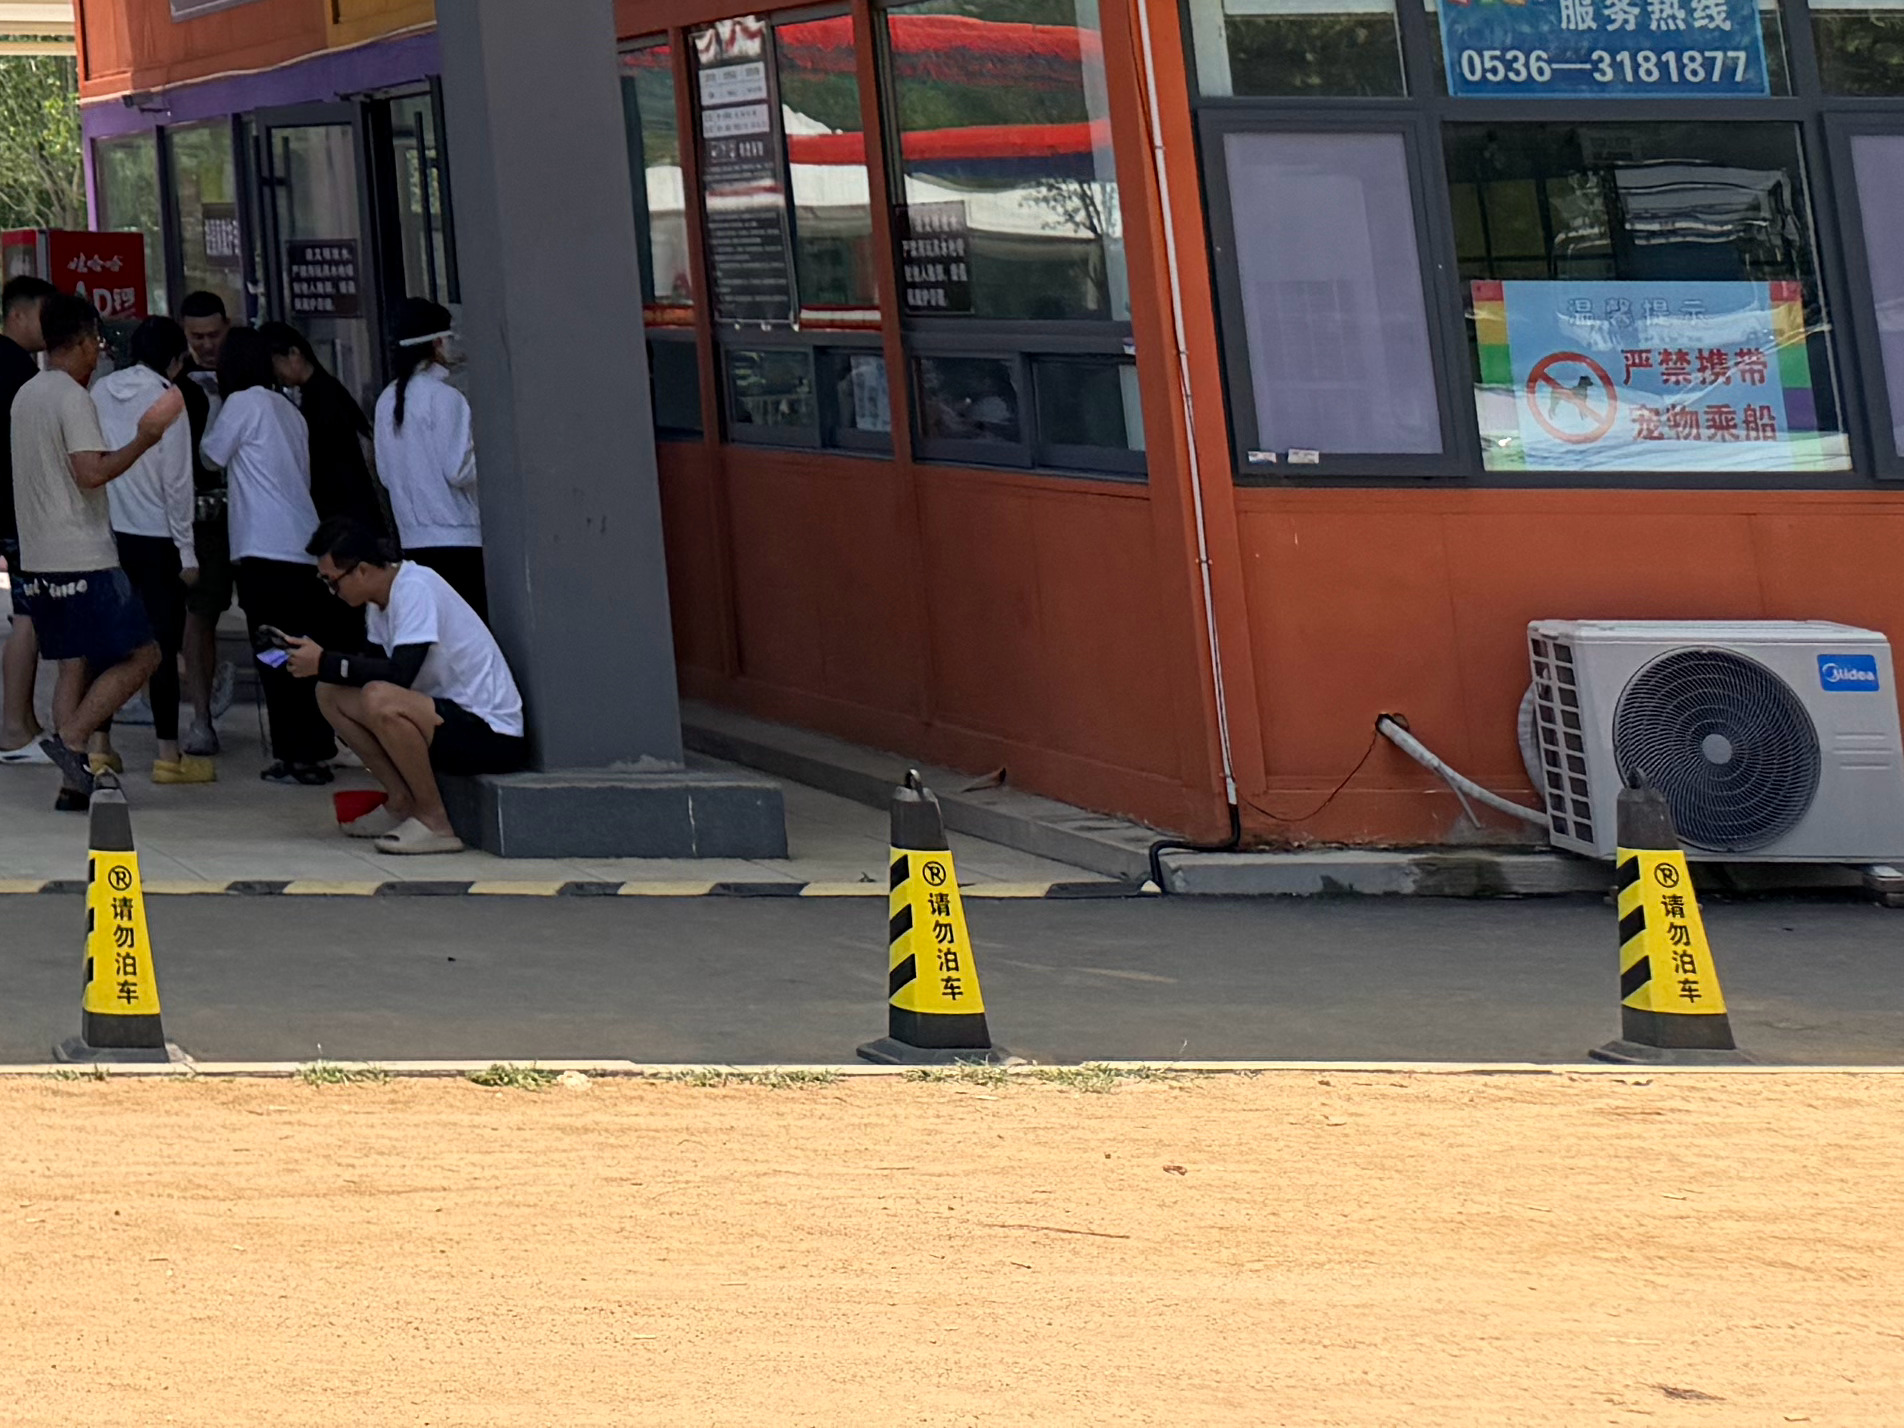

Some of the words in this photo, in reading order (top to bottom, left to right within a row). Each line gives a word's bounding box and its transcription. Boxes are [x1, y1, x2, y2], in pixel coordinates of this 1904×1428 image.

[1568, 298, 1707, 326] 温馨提示
[1621, 347, 1768, 387] 严禁携带
[1628, 403, 1777, 443] 宠物乘船
[110, 896, 140, 1005] 请勿泊车
[927, 892, 965, 1001] 请勿泊车
[1659, 894, 1703, 1004] 请勿泊车
